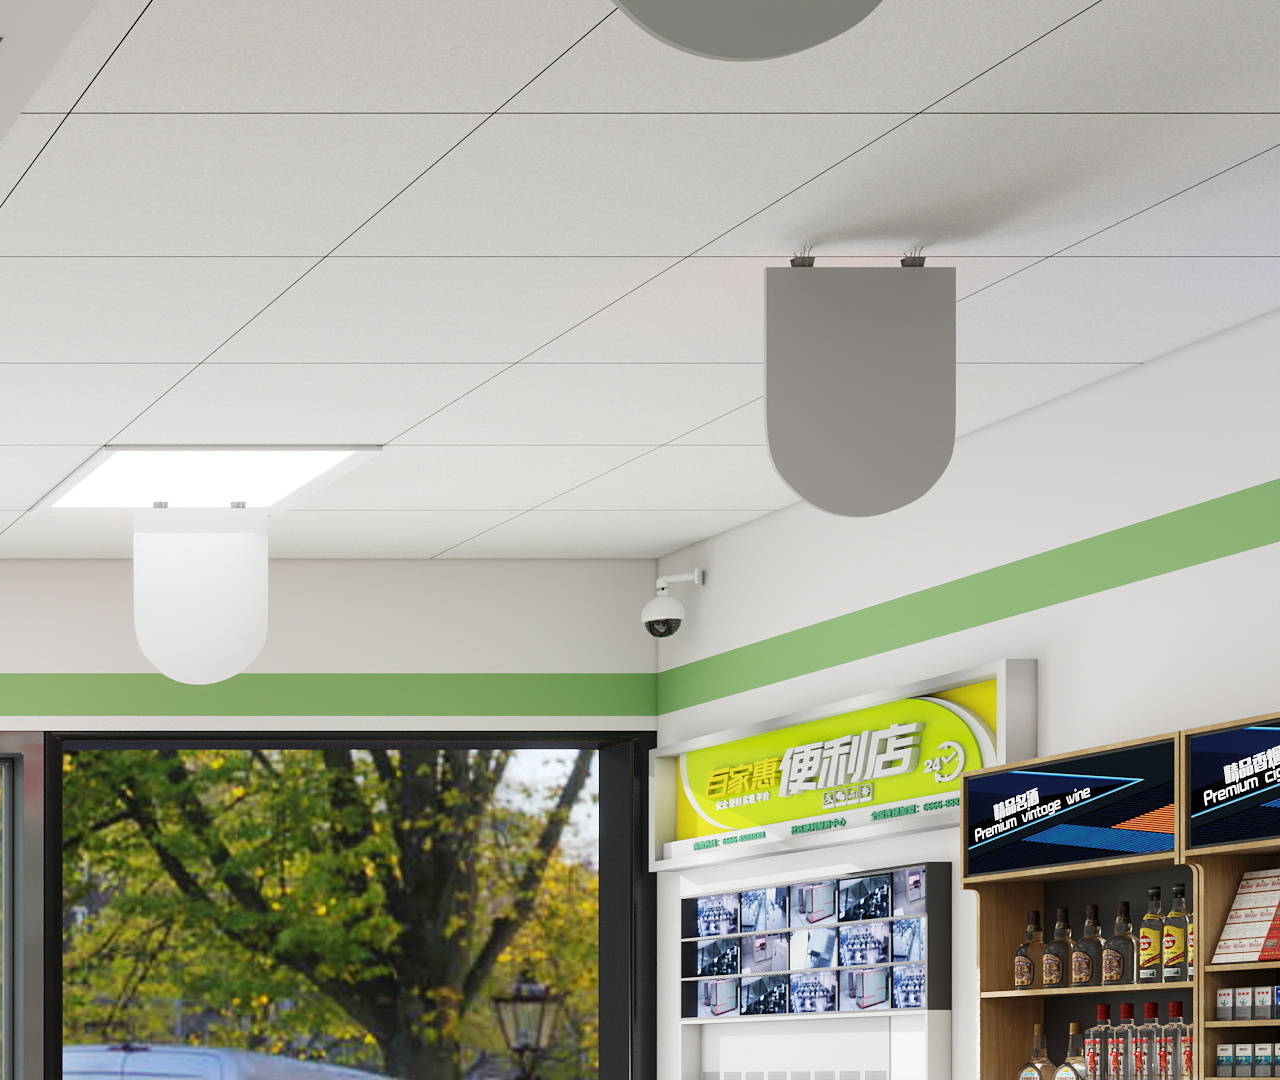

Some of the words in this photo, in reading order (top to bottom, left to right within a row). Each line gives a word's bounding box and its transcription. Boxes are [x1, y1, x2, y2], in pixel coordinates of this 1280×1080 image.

[705, 756, 781, 800] 百家惠
[778, 722, 925, 798] 便利店
[924, 757, 941, 774] 24
[993, 787, 1040, 821] 精品名酒
[1203, 777, 1259, 807] Premium
[974, 817, 1018, 842] Premium
[1021, 801, 1062, 824] vintage
[1066, 787, 1091, 806] wine
